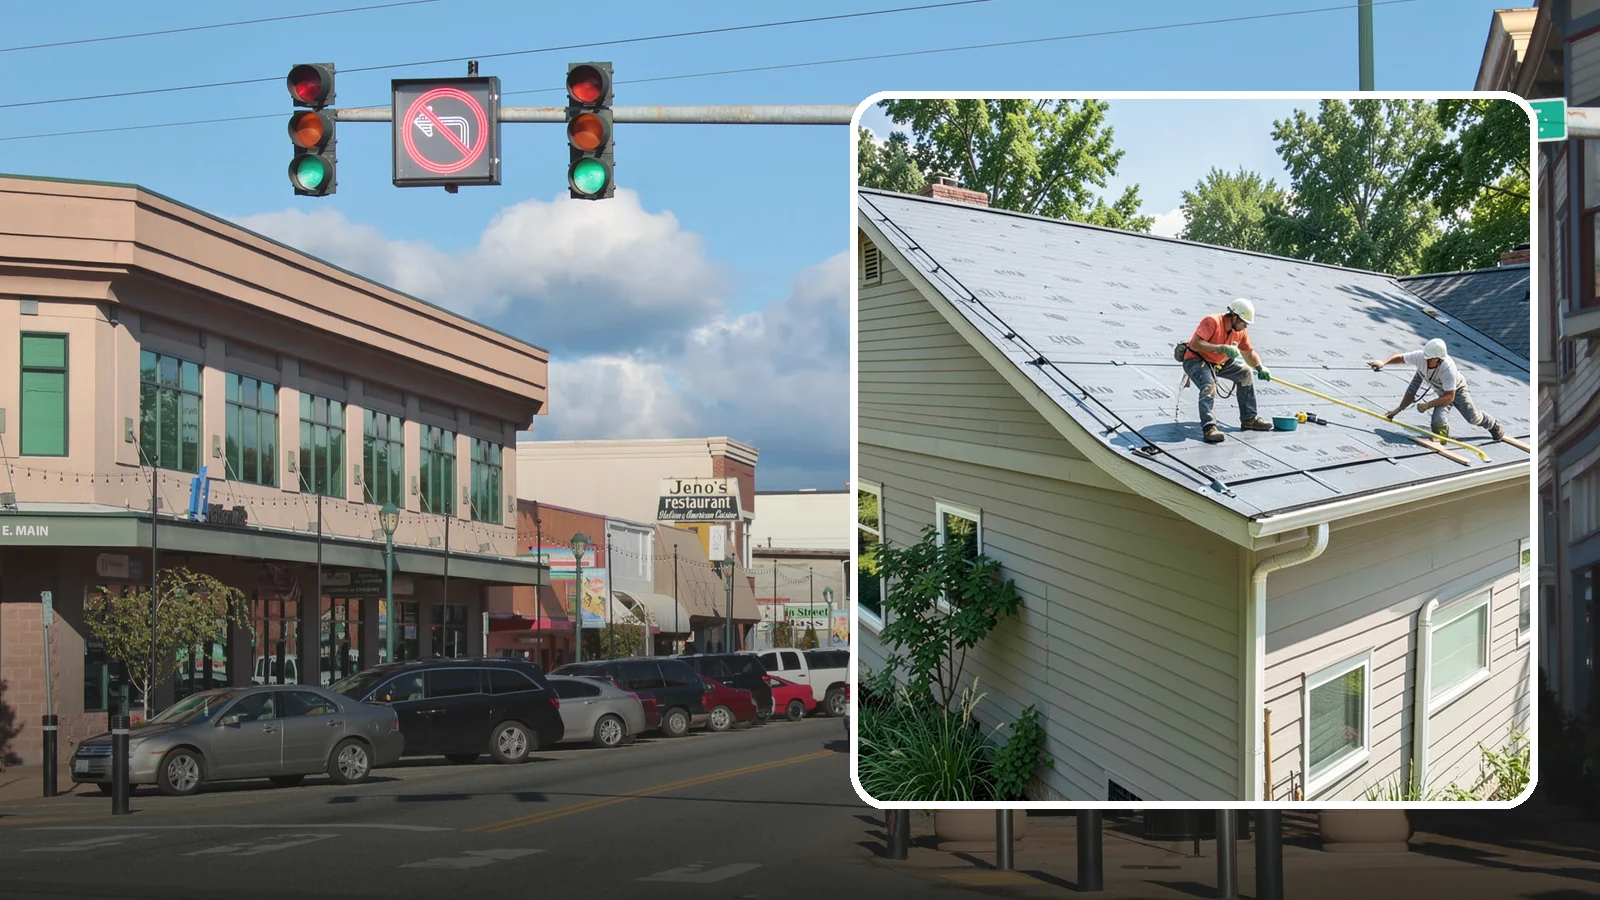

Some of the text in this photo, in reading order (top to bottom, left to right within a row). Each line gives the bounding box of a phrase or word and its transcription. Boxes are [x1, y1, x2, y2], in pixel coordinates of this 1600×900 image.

[670, 480, 728, 495] Jeno's
[665, 496, 731, 509] restaurant
[658, 509, 682, 520] Italian
[686, 509, 715, 520] American
[715, 509, 738, 520] Cuisine
[3, 525, 48, 536] E. MAIN
[797, 608, 828, 617] Street
